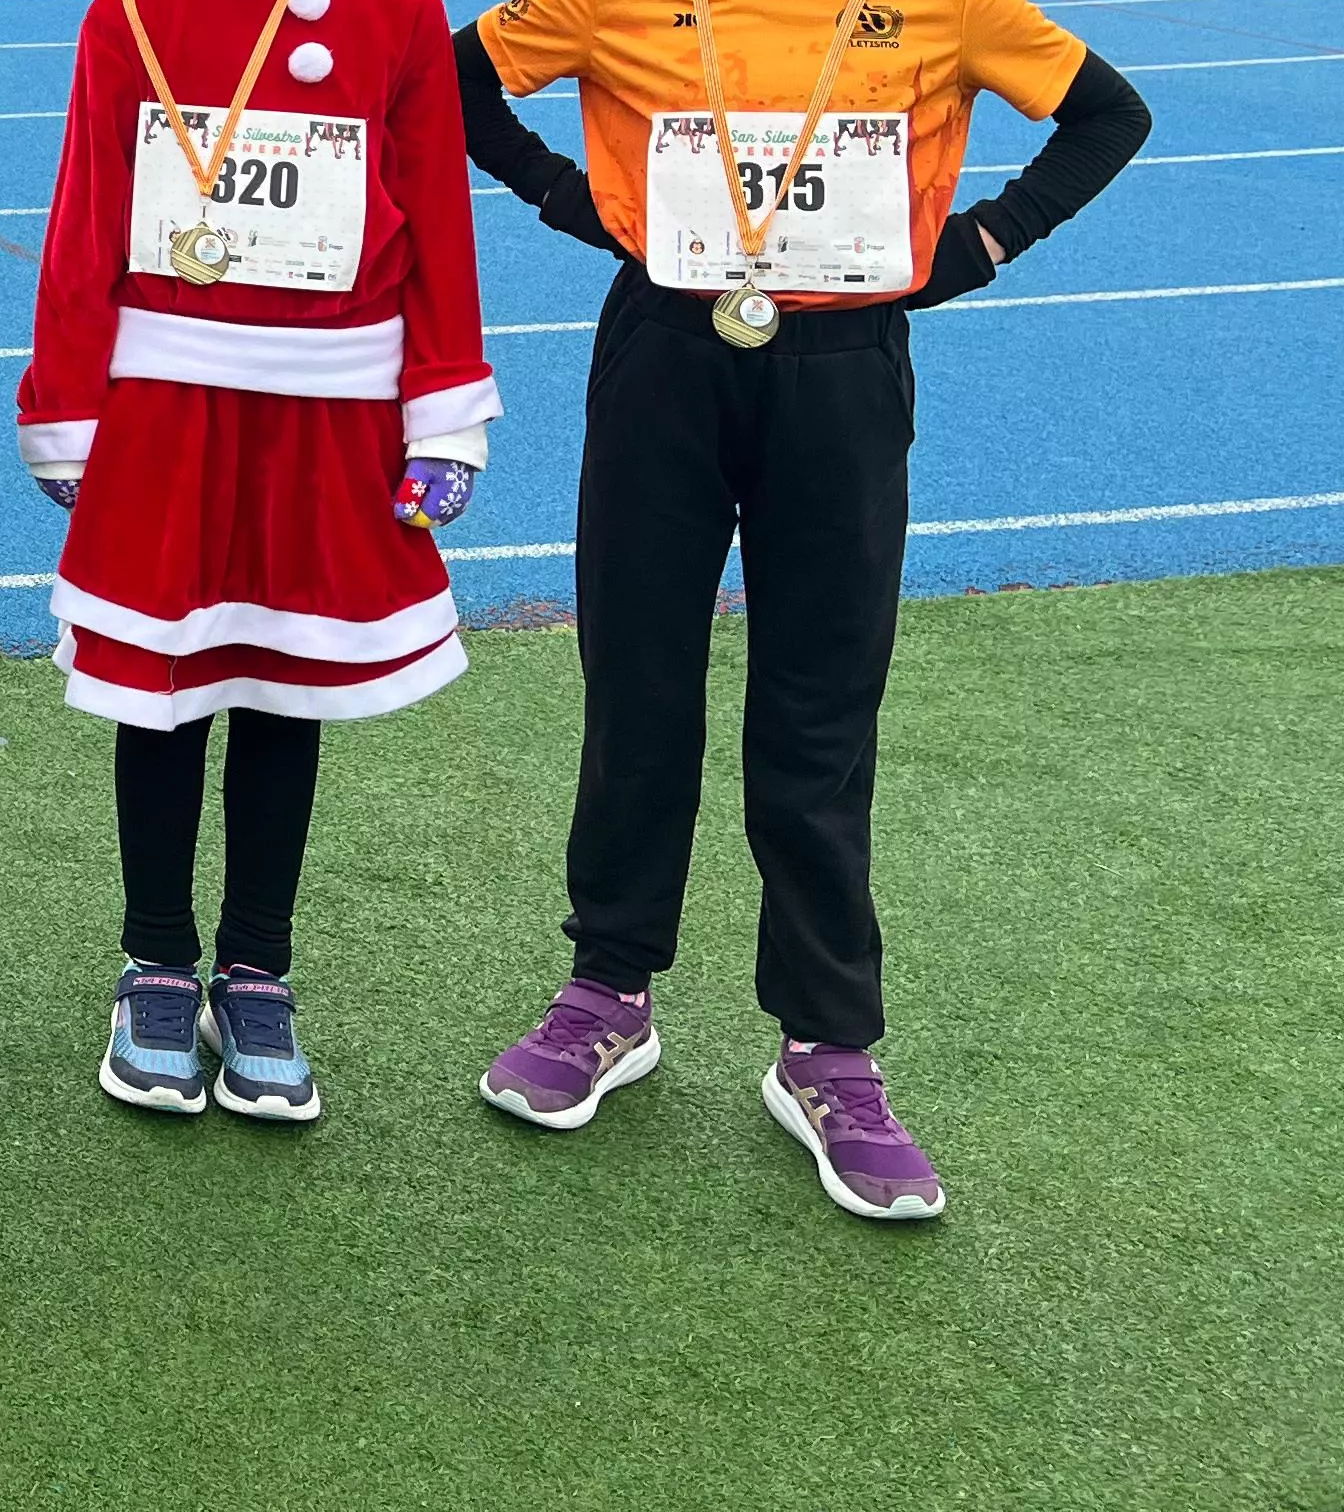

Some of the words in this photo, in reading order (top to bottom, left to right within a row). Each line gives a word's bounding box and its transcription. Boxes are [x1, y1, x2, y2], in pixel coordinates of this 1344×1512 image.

[849, 40, 900, 49] LETISMO
[242, 127, 302, 144] Silvestre
[731, 129, 758, 143] San
[761, 129, 830, 144] Silvere
[211, 156, 299, 209] 320
[737, 161, 825, 212] 315
